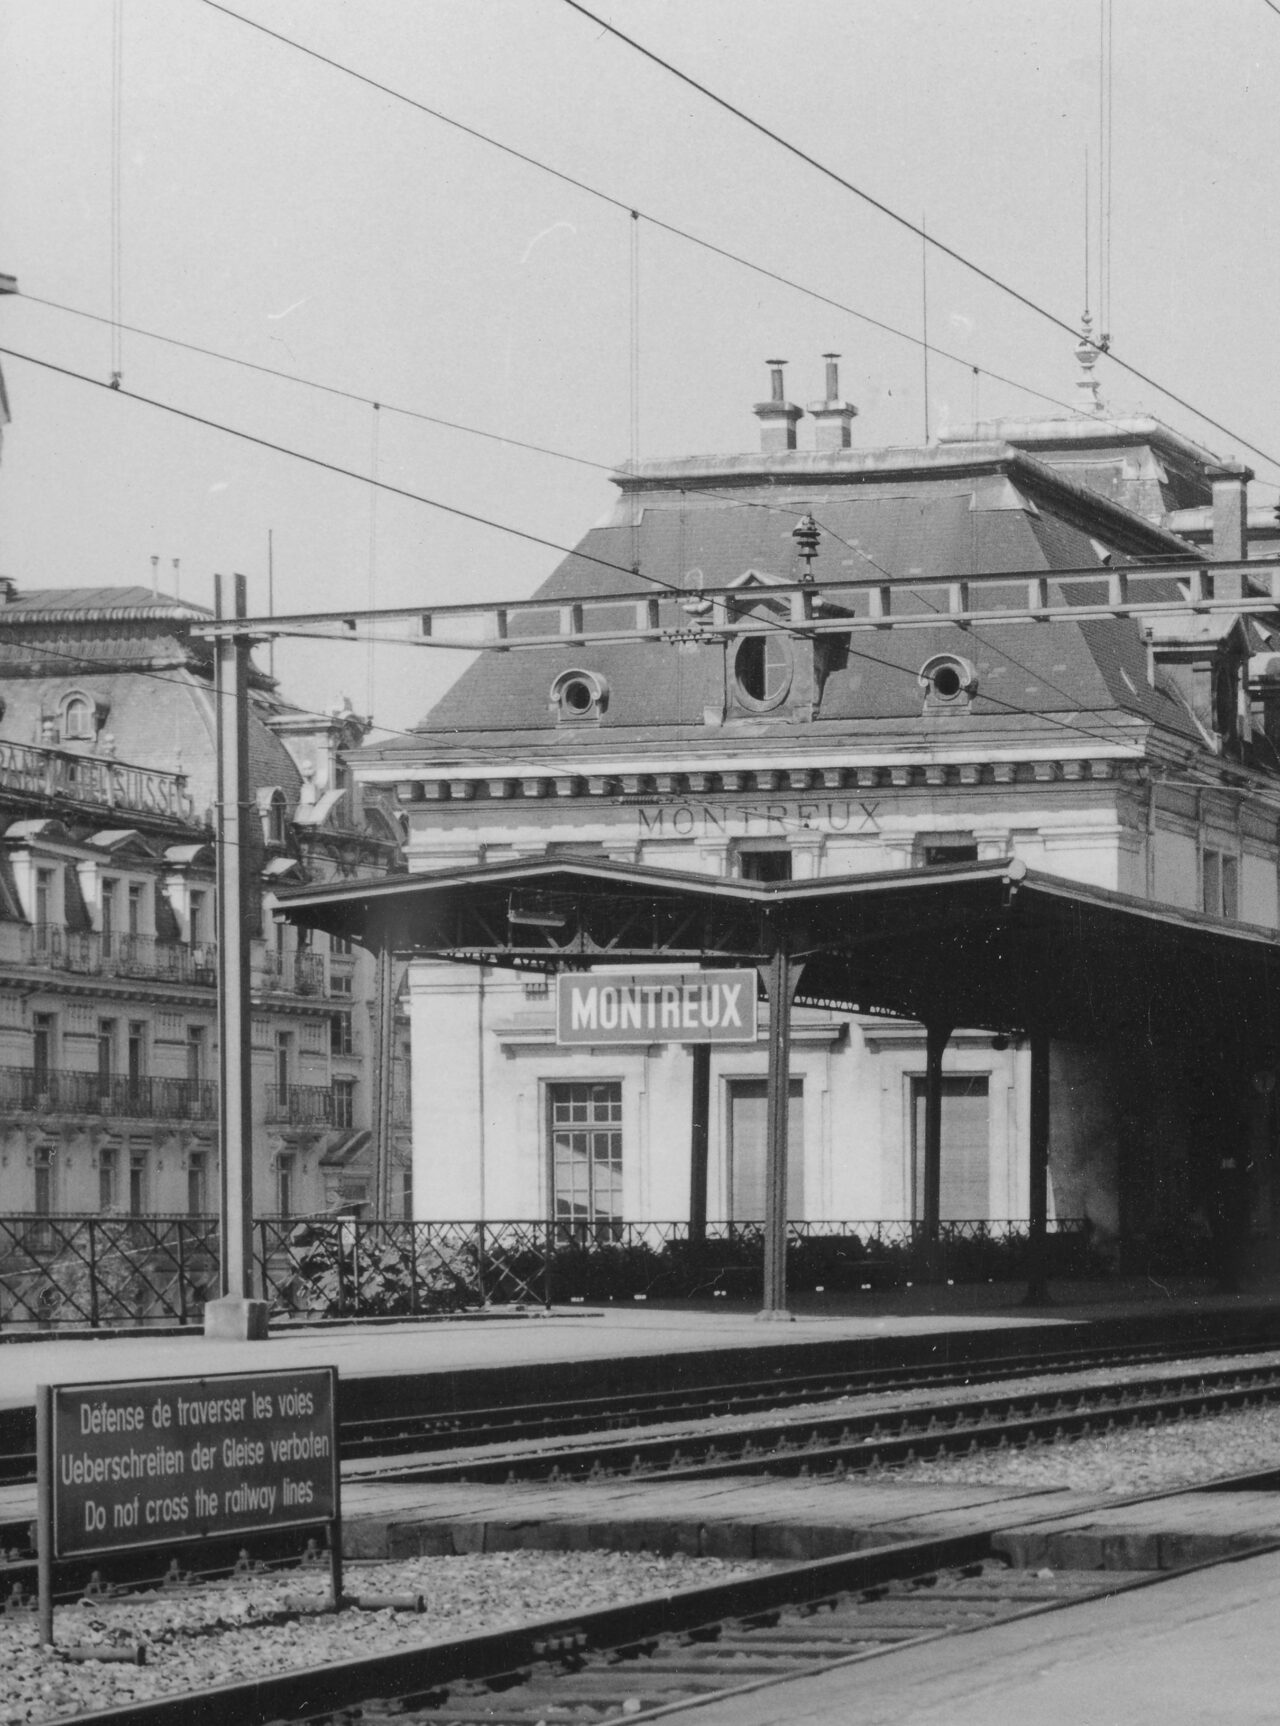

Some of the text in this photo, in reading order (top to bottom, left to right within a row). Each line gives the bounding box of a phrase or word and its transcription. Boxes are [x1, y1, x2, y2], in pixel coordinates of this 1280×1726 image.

[637, 802, 882, 835] MONTREUX
[571, 984, 742, 1030] MONTREUX
[152, 1398, 171, 1428] de
[178, 1397, 246, 1425] traverser
[252, 1390, 273, 1419] les
[278, 1387, 314, 1417] voies
[61, 1431, 329, 1485] Ueberschreiten der Gleise verboten
[85, 1478, 314, 1531] Do not cross the railway lines
